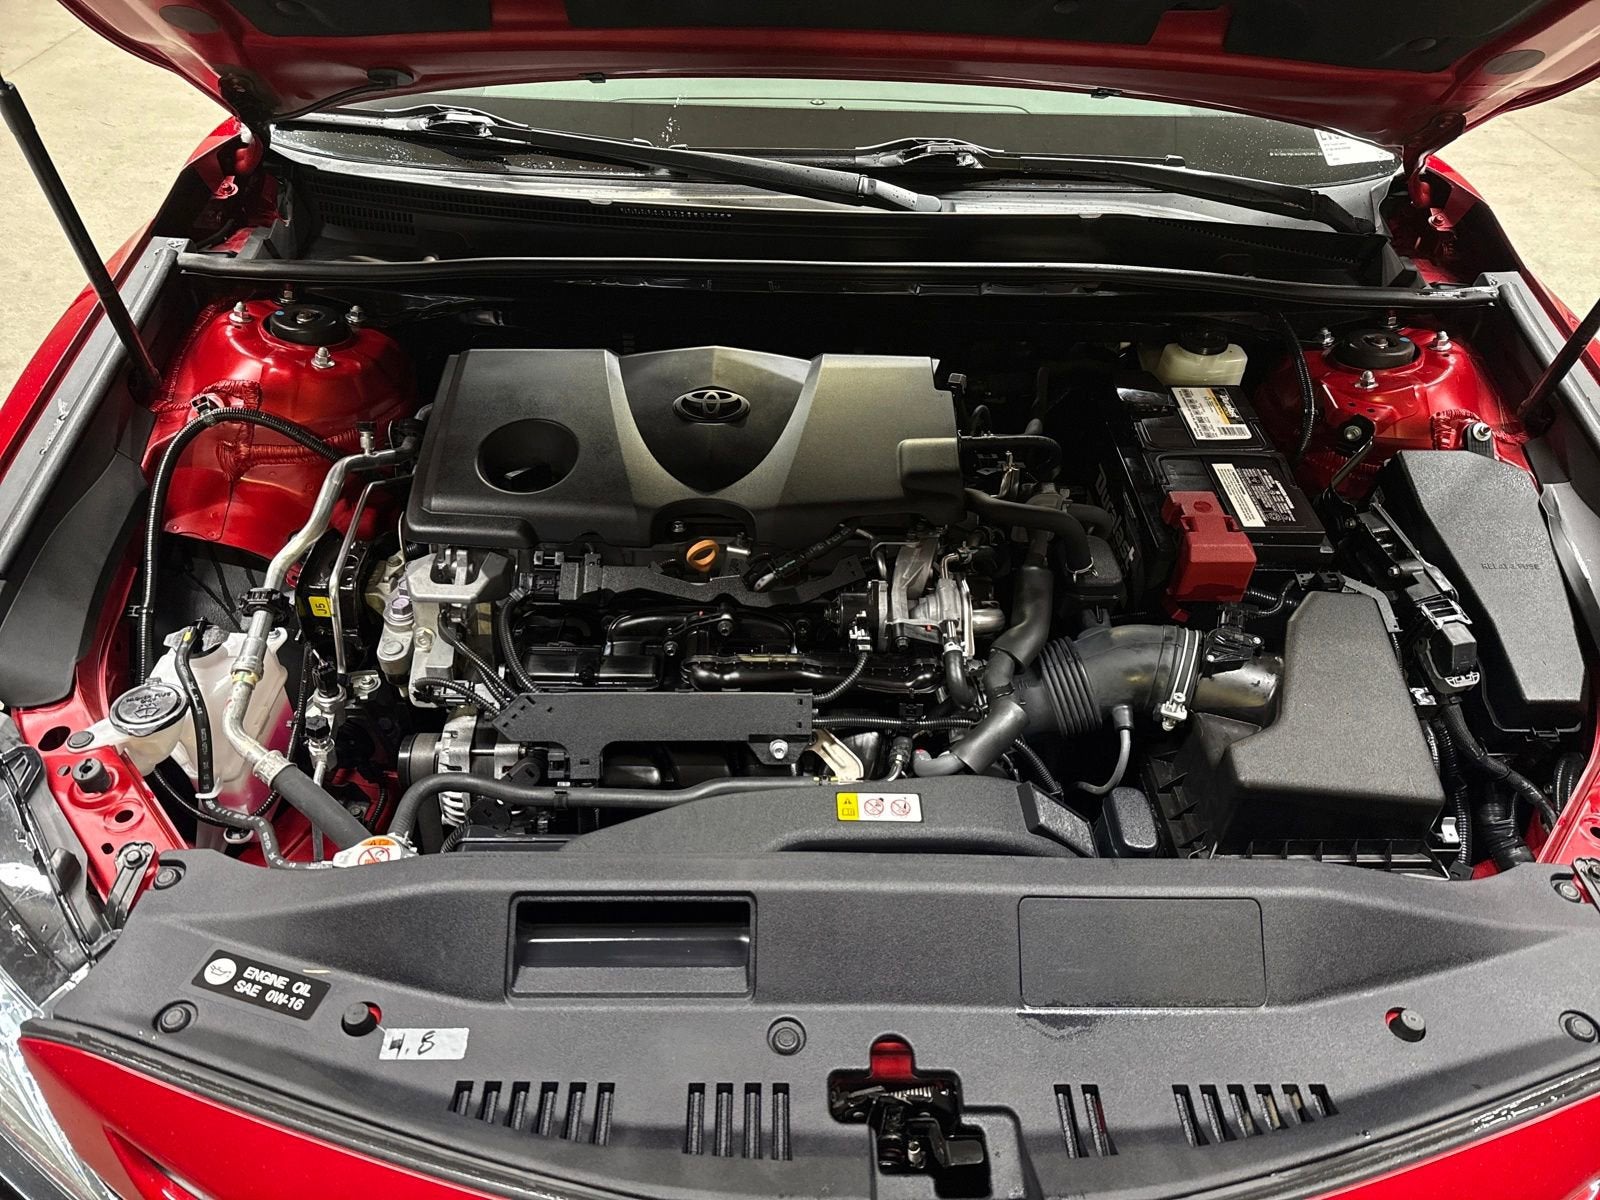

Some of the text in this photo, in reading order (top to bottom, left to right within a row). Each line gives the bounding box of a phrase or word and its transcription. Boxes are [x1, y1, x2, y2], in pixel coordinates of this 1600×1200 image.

[233, 979, 306, 1011] SAE 0W-16
[242, 966, 312, 998] ENGINE OIL
